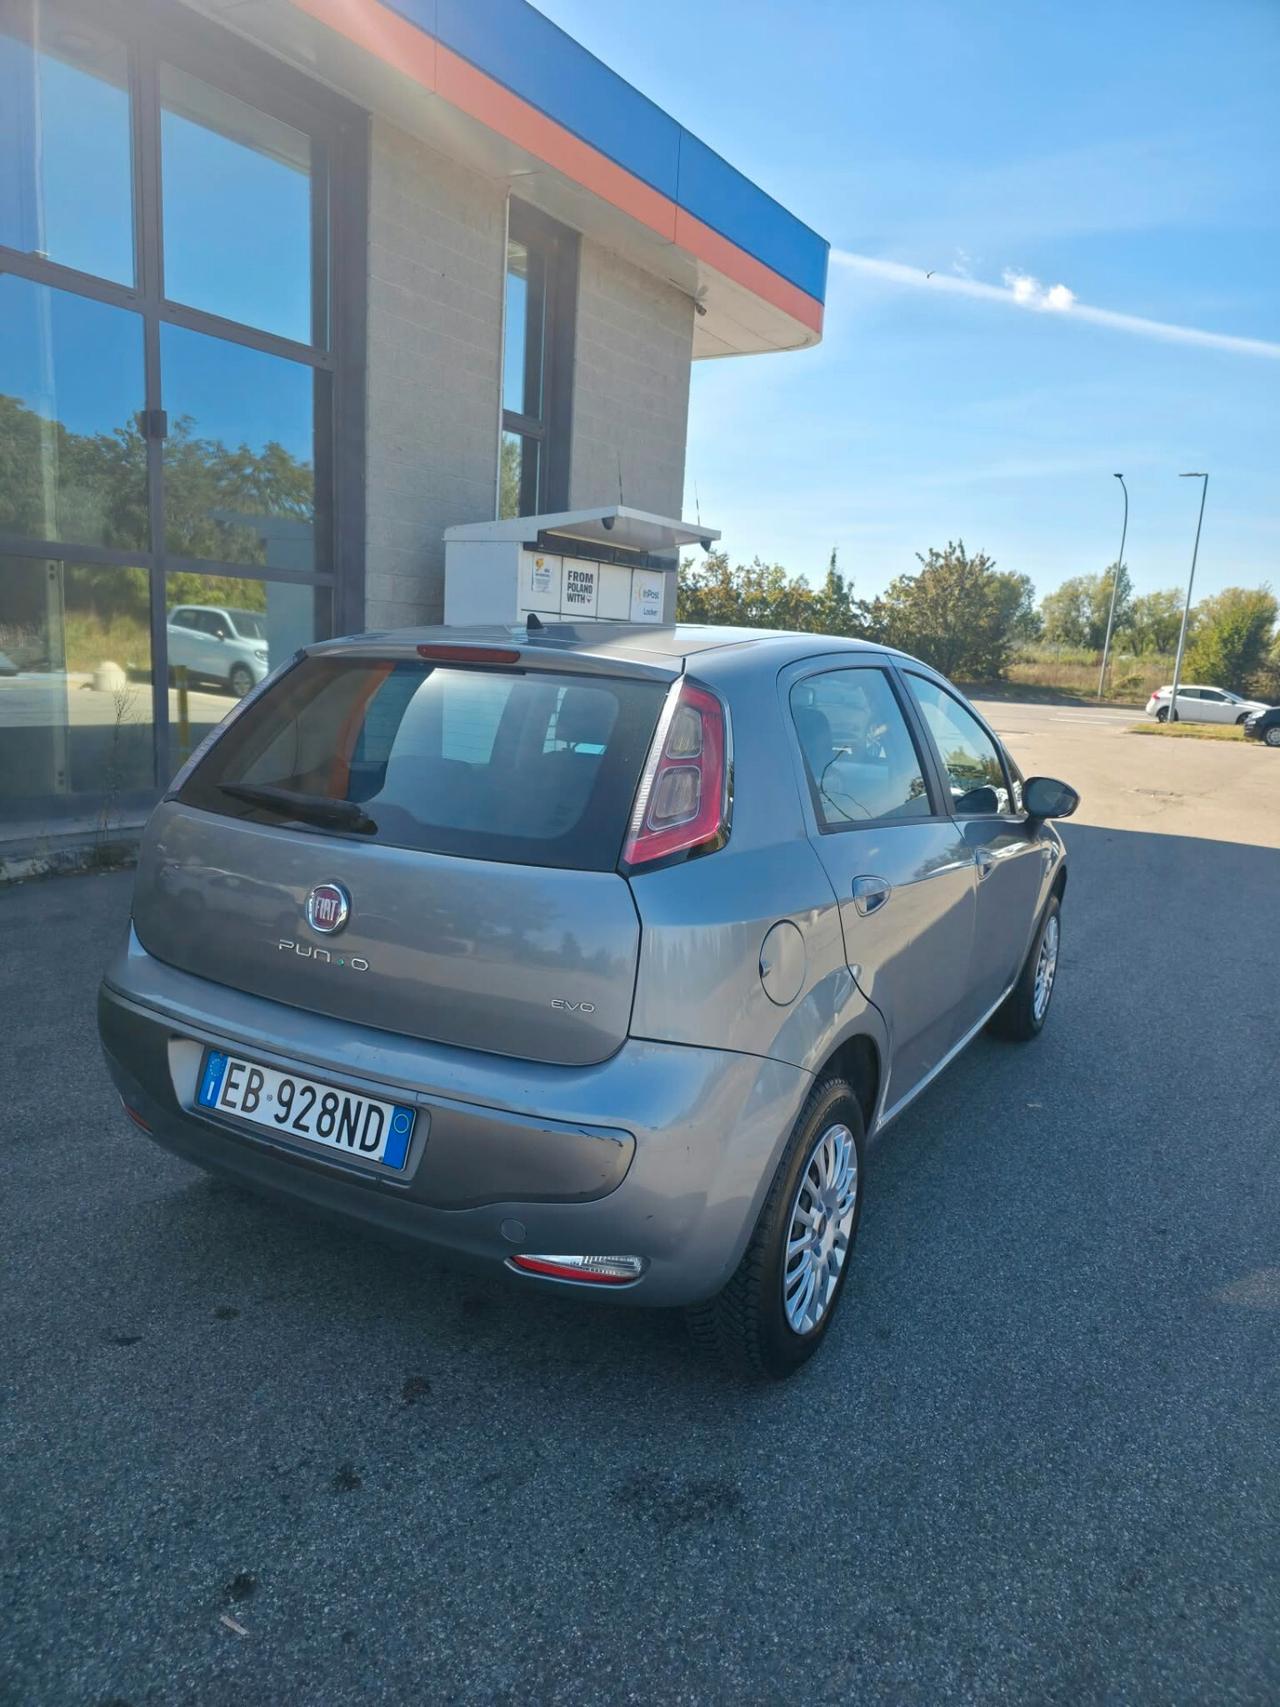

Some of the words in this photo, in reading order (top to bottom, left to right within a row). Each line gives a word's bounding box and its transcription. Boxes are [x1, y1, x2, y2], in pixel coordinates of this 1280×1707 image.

[567, 570, 594, 584] FROM
[567, 582, 593, 594] POLAND
[567, 592, 586, 604] WITH
[314, 897, 339, 921] FIAT
[279, 939, 369, 971] PUNO
[551, 999, 595, 1013] EVO
[219, 1061, 265, 1114] EB
[273, 1078, 385, 1153] 928ND
